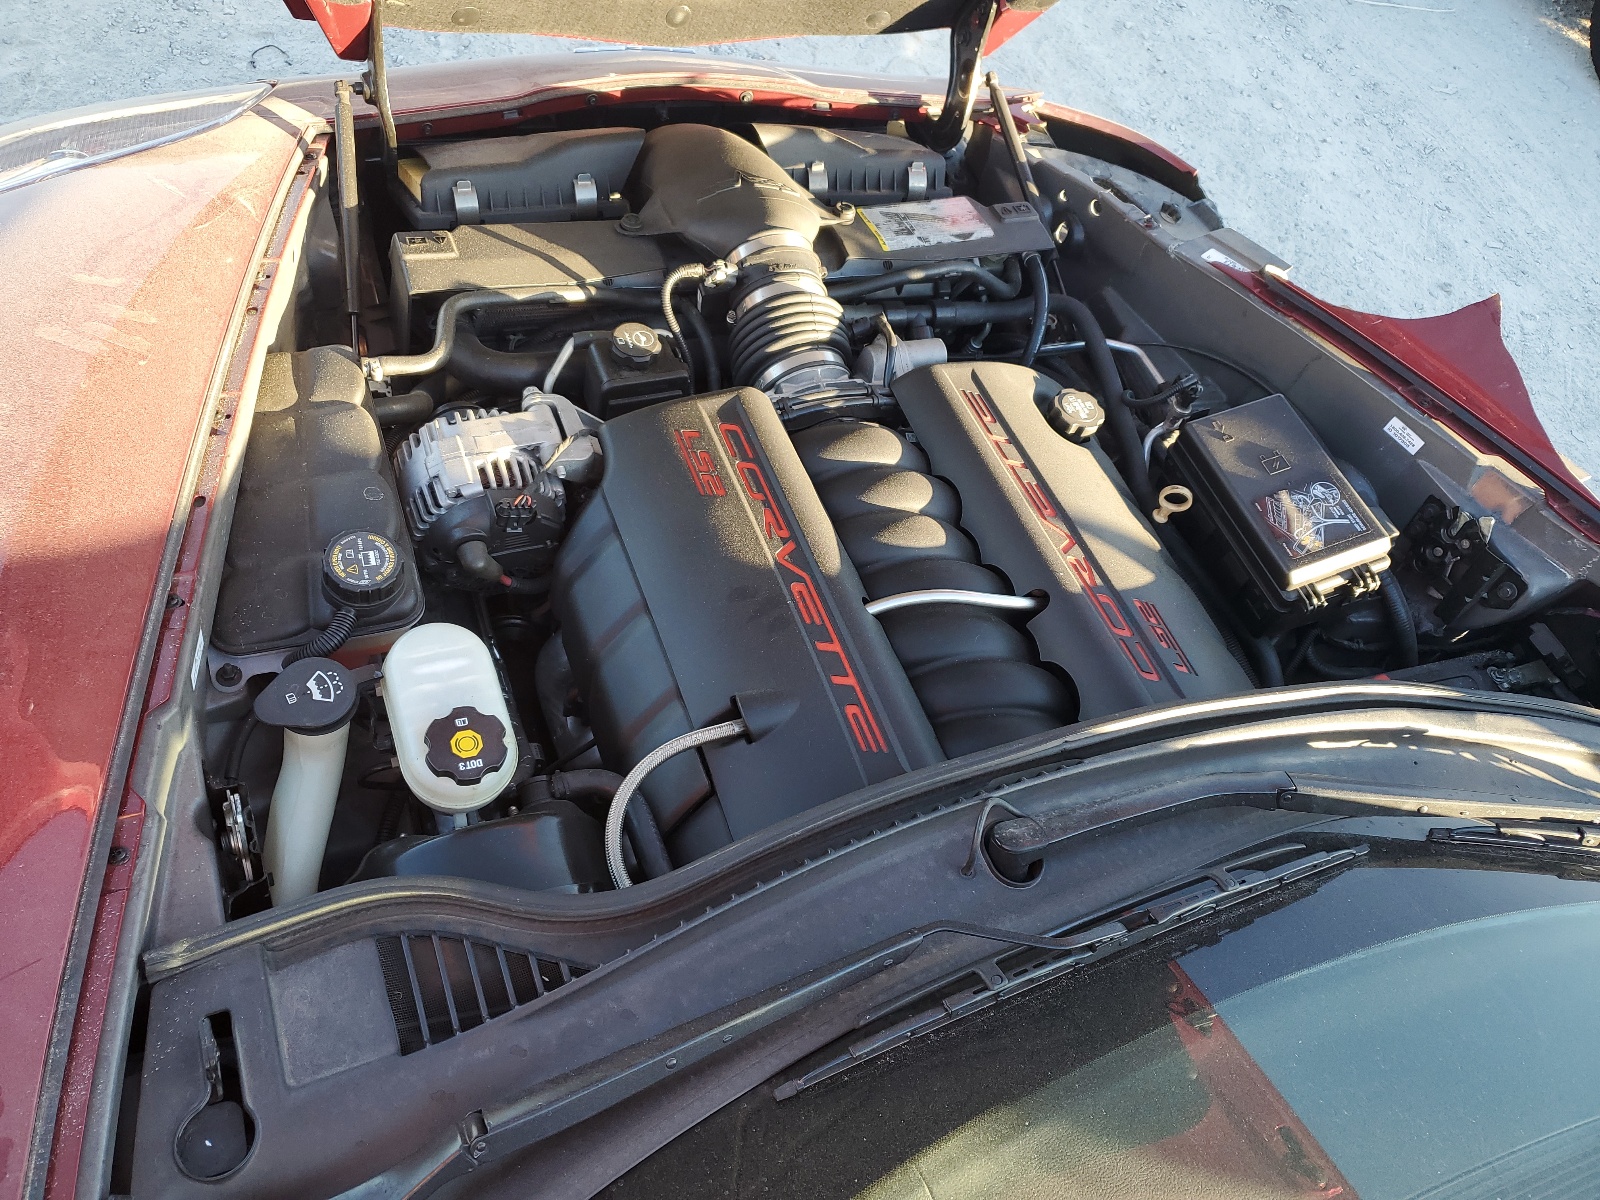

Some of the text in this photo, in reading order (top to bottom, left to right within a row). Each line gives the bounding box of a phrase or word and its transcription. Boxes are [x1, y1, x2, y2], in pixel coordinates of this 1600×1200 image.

[674, 429, 726, 496] LS2
[960, 388, 1161, 682] CORVETTE
[718, 422, 888, 753] CORVETTE
[1133, 598, 1198, 677] LS2
